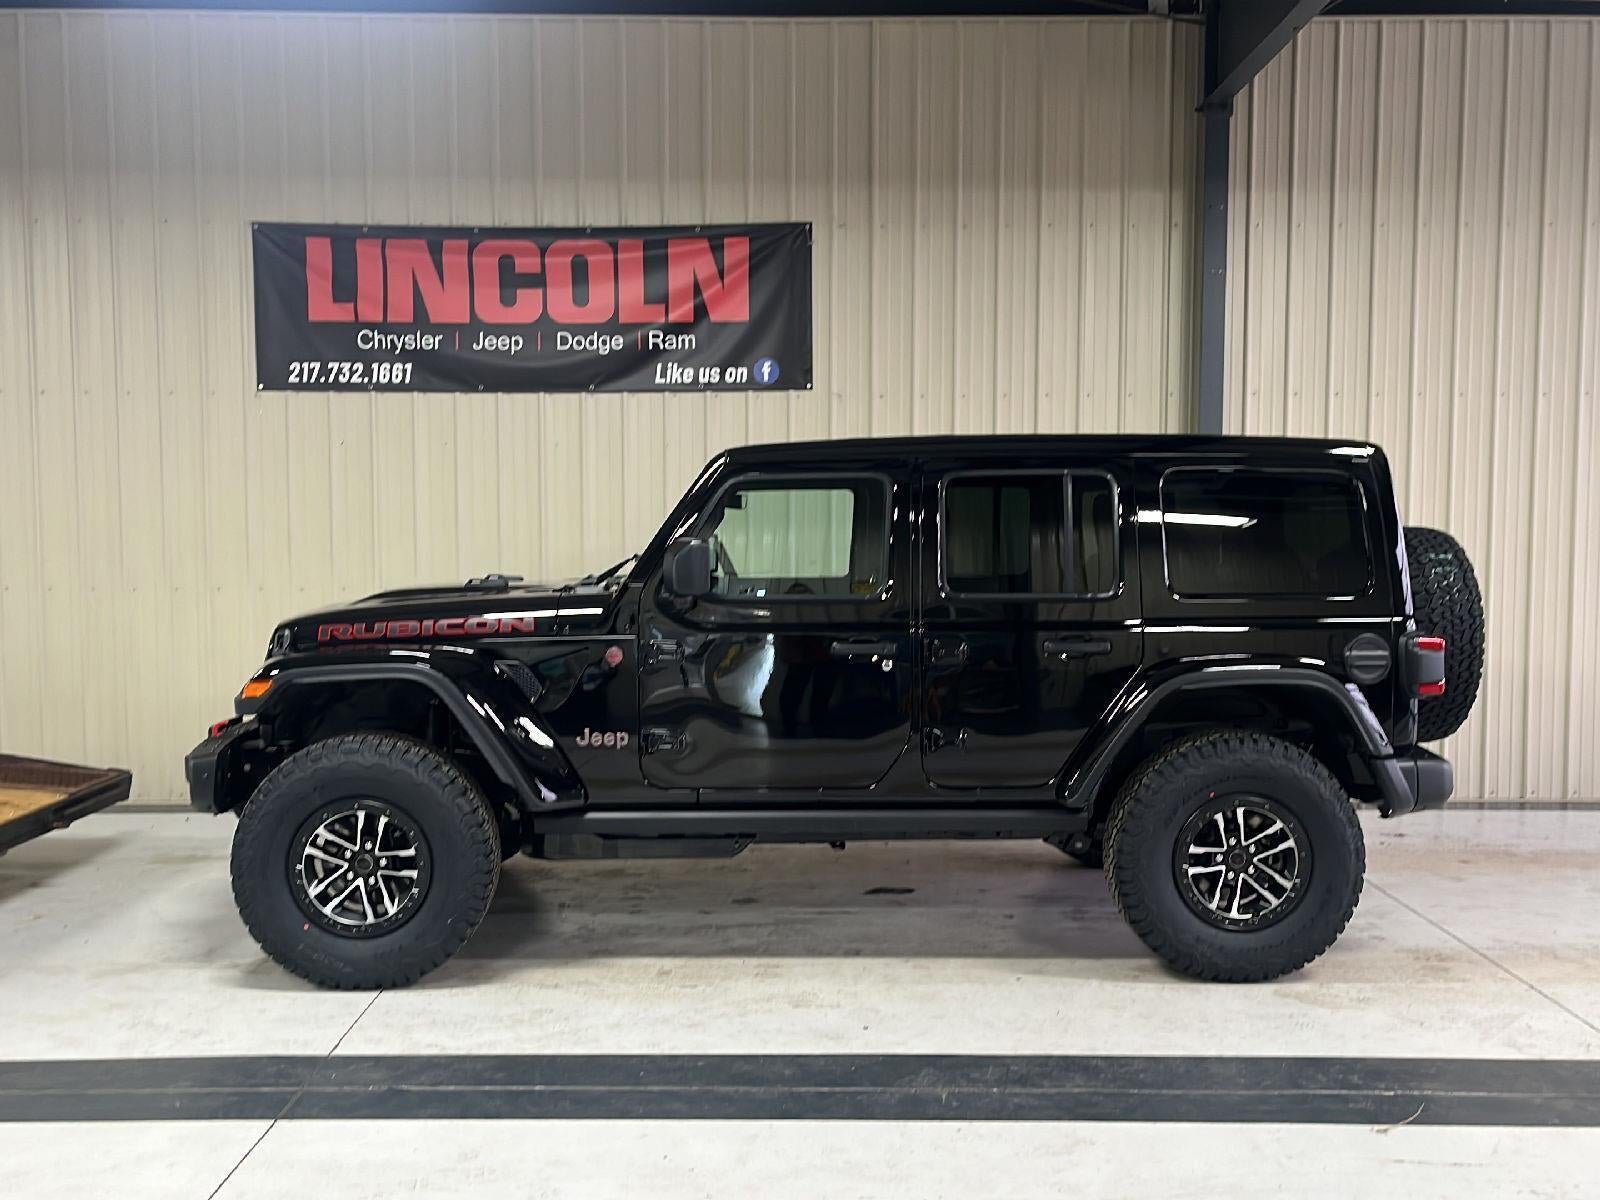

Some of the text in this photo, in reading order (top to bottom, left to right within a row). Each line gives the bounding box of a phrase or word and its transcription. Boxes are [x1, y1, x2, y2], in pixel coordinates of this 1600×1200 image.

[305, 235, 750, 324] LINCOLN
[357, 329, 696, 355] Chrysler Jeep Dodge Ram
[288, 361, 413, 384] 217.732.1661
[655, 362, 694, 383] Like
[698, 366, 721, 384] us
[723, 366, 748, 384] on
[317, 616, 535, 641] RUBICON
[575, 727, 629, 749] Jeep
